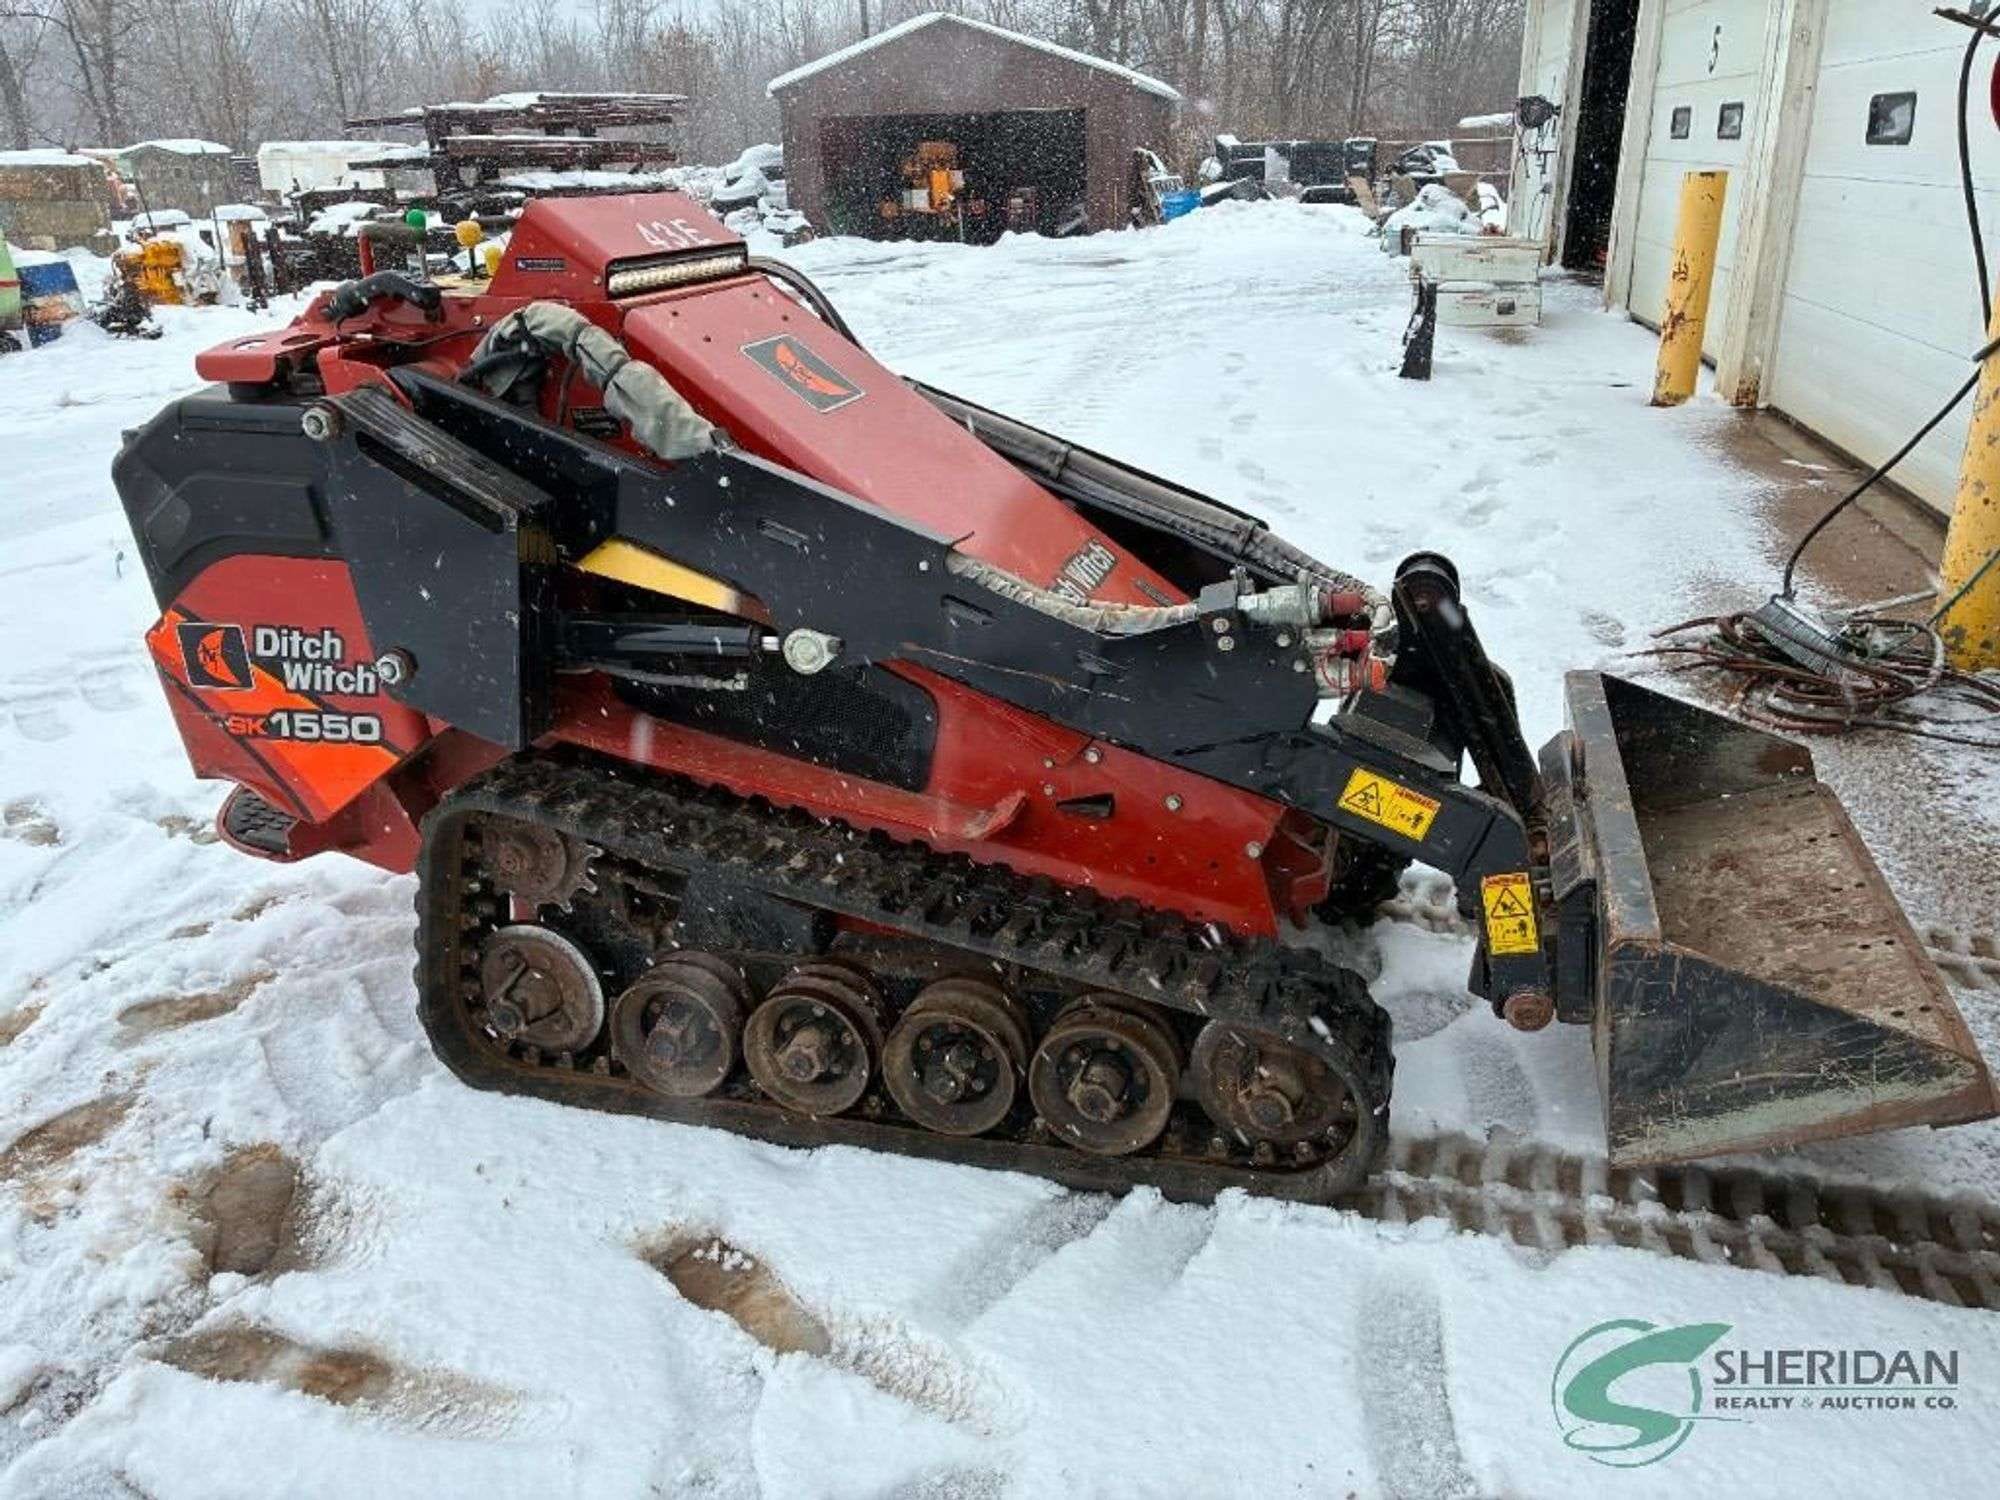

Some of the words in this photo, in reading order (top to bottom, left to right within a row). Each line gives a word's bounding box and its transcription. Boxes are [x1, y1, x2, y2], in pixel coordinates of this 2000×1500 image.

[1065, 542, 1115, 590] Witch
[255, 628, 342, 660] Ditch
[282, 662, 377, 694] Witch
